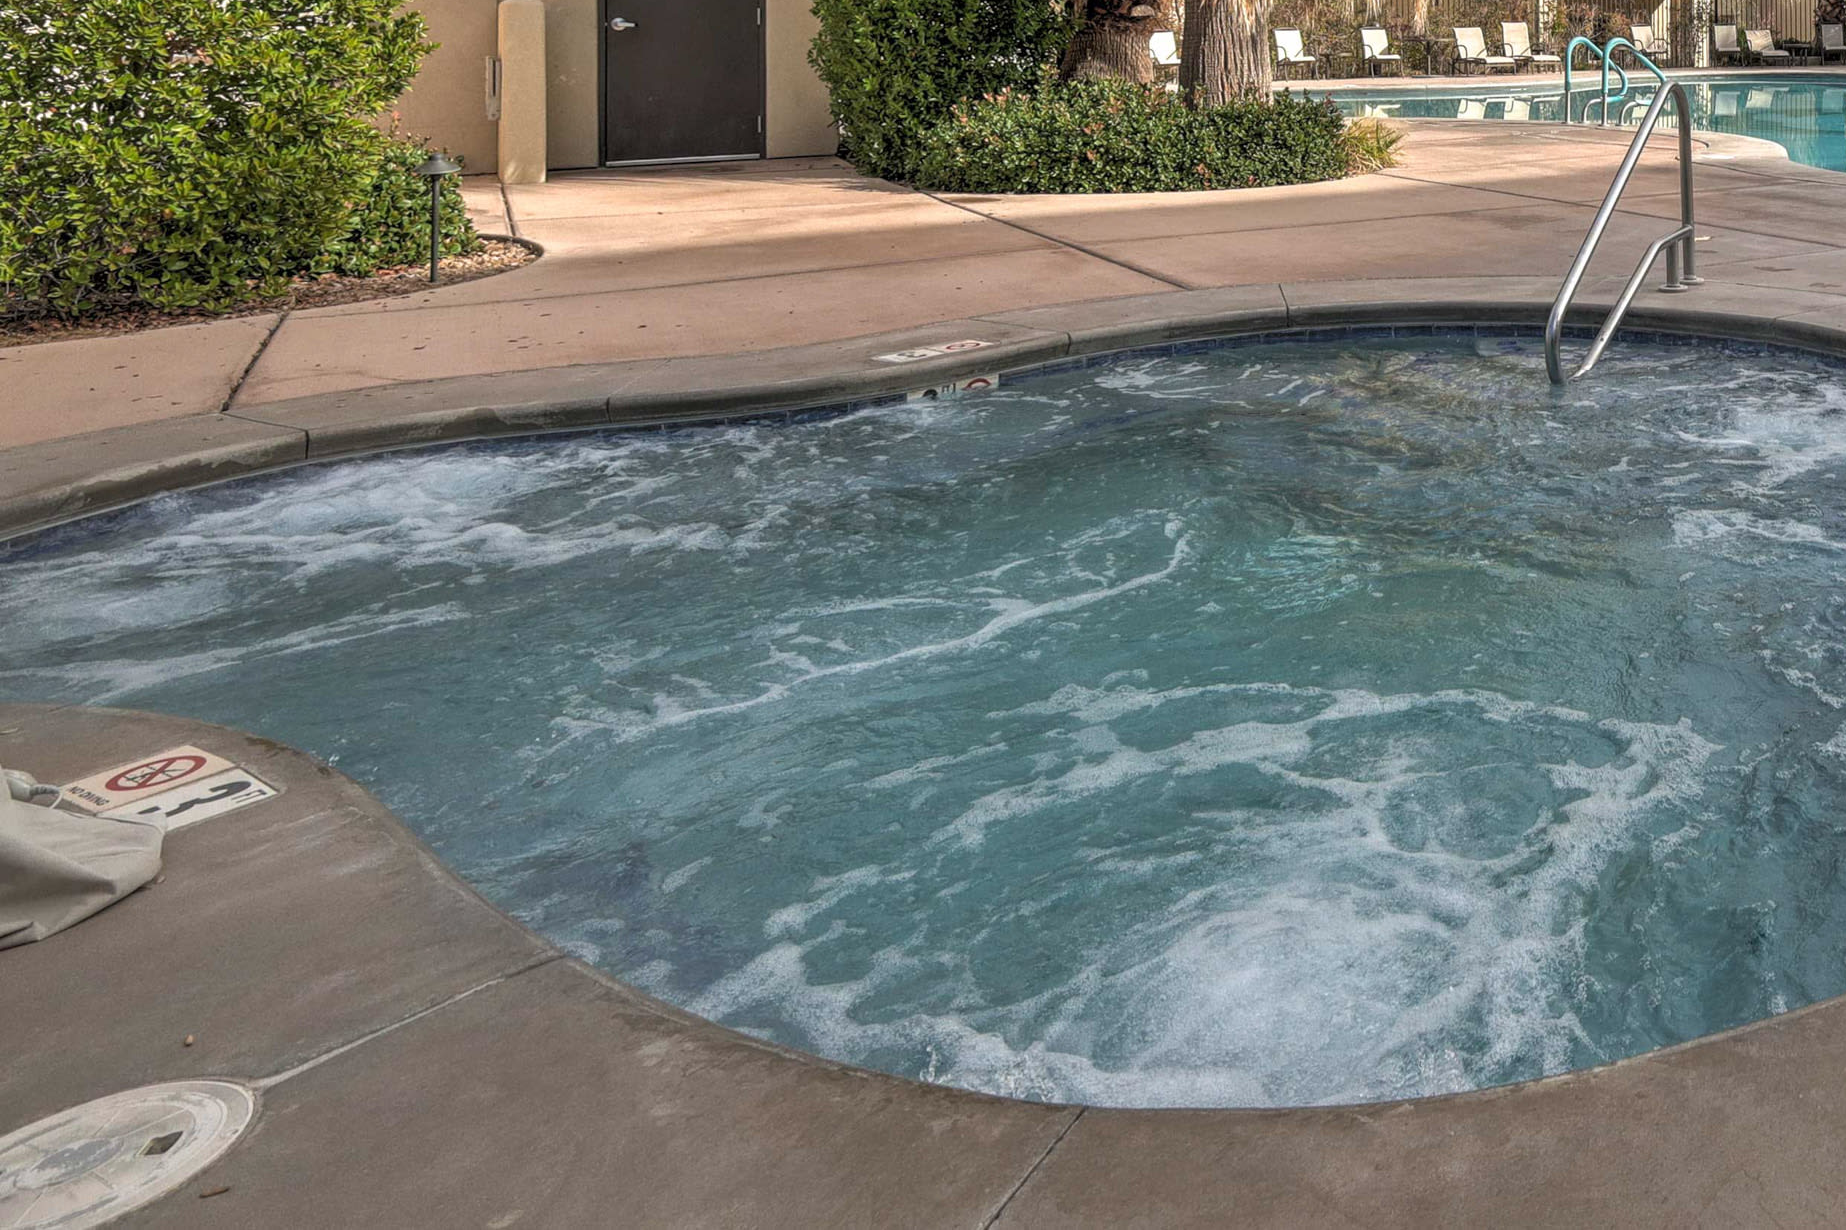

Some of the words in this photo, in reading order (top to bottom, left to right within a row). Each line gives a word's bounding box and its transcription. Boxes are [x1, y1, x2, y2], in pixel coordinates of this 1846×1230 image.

[69, 786, 86, 795] NO
[79, 791, 110, 806] DIVING
[231, 789, 267, 803] FT
